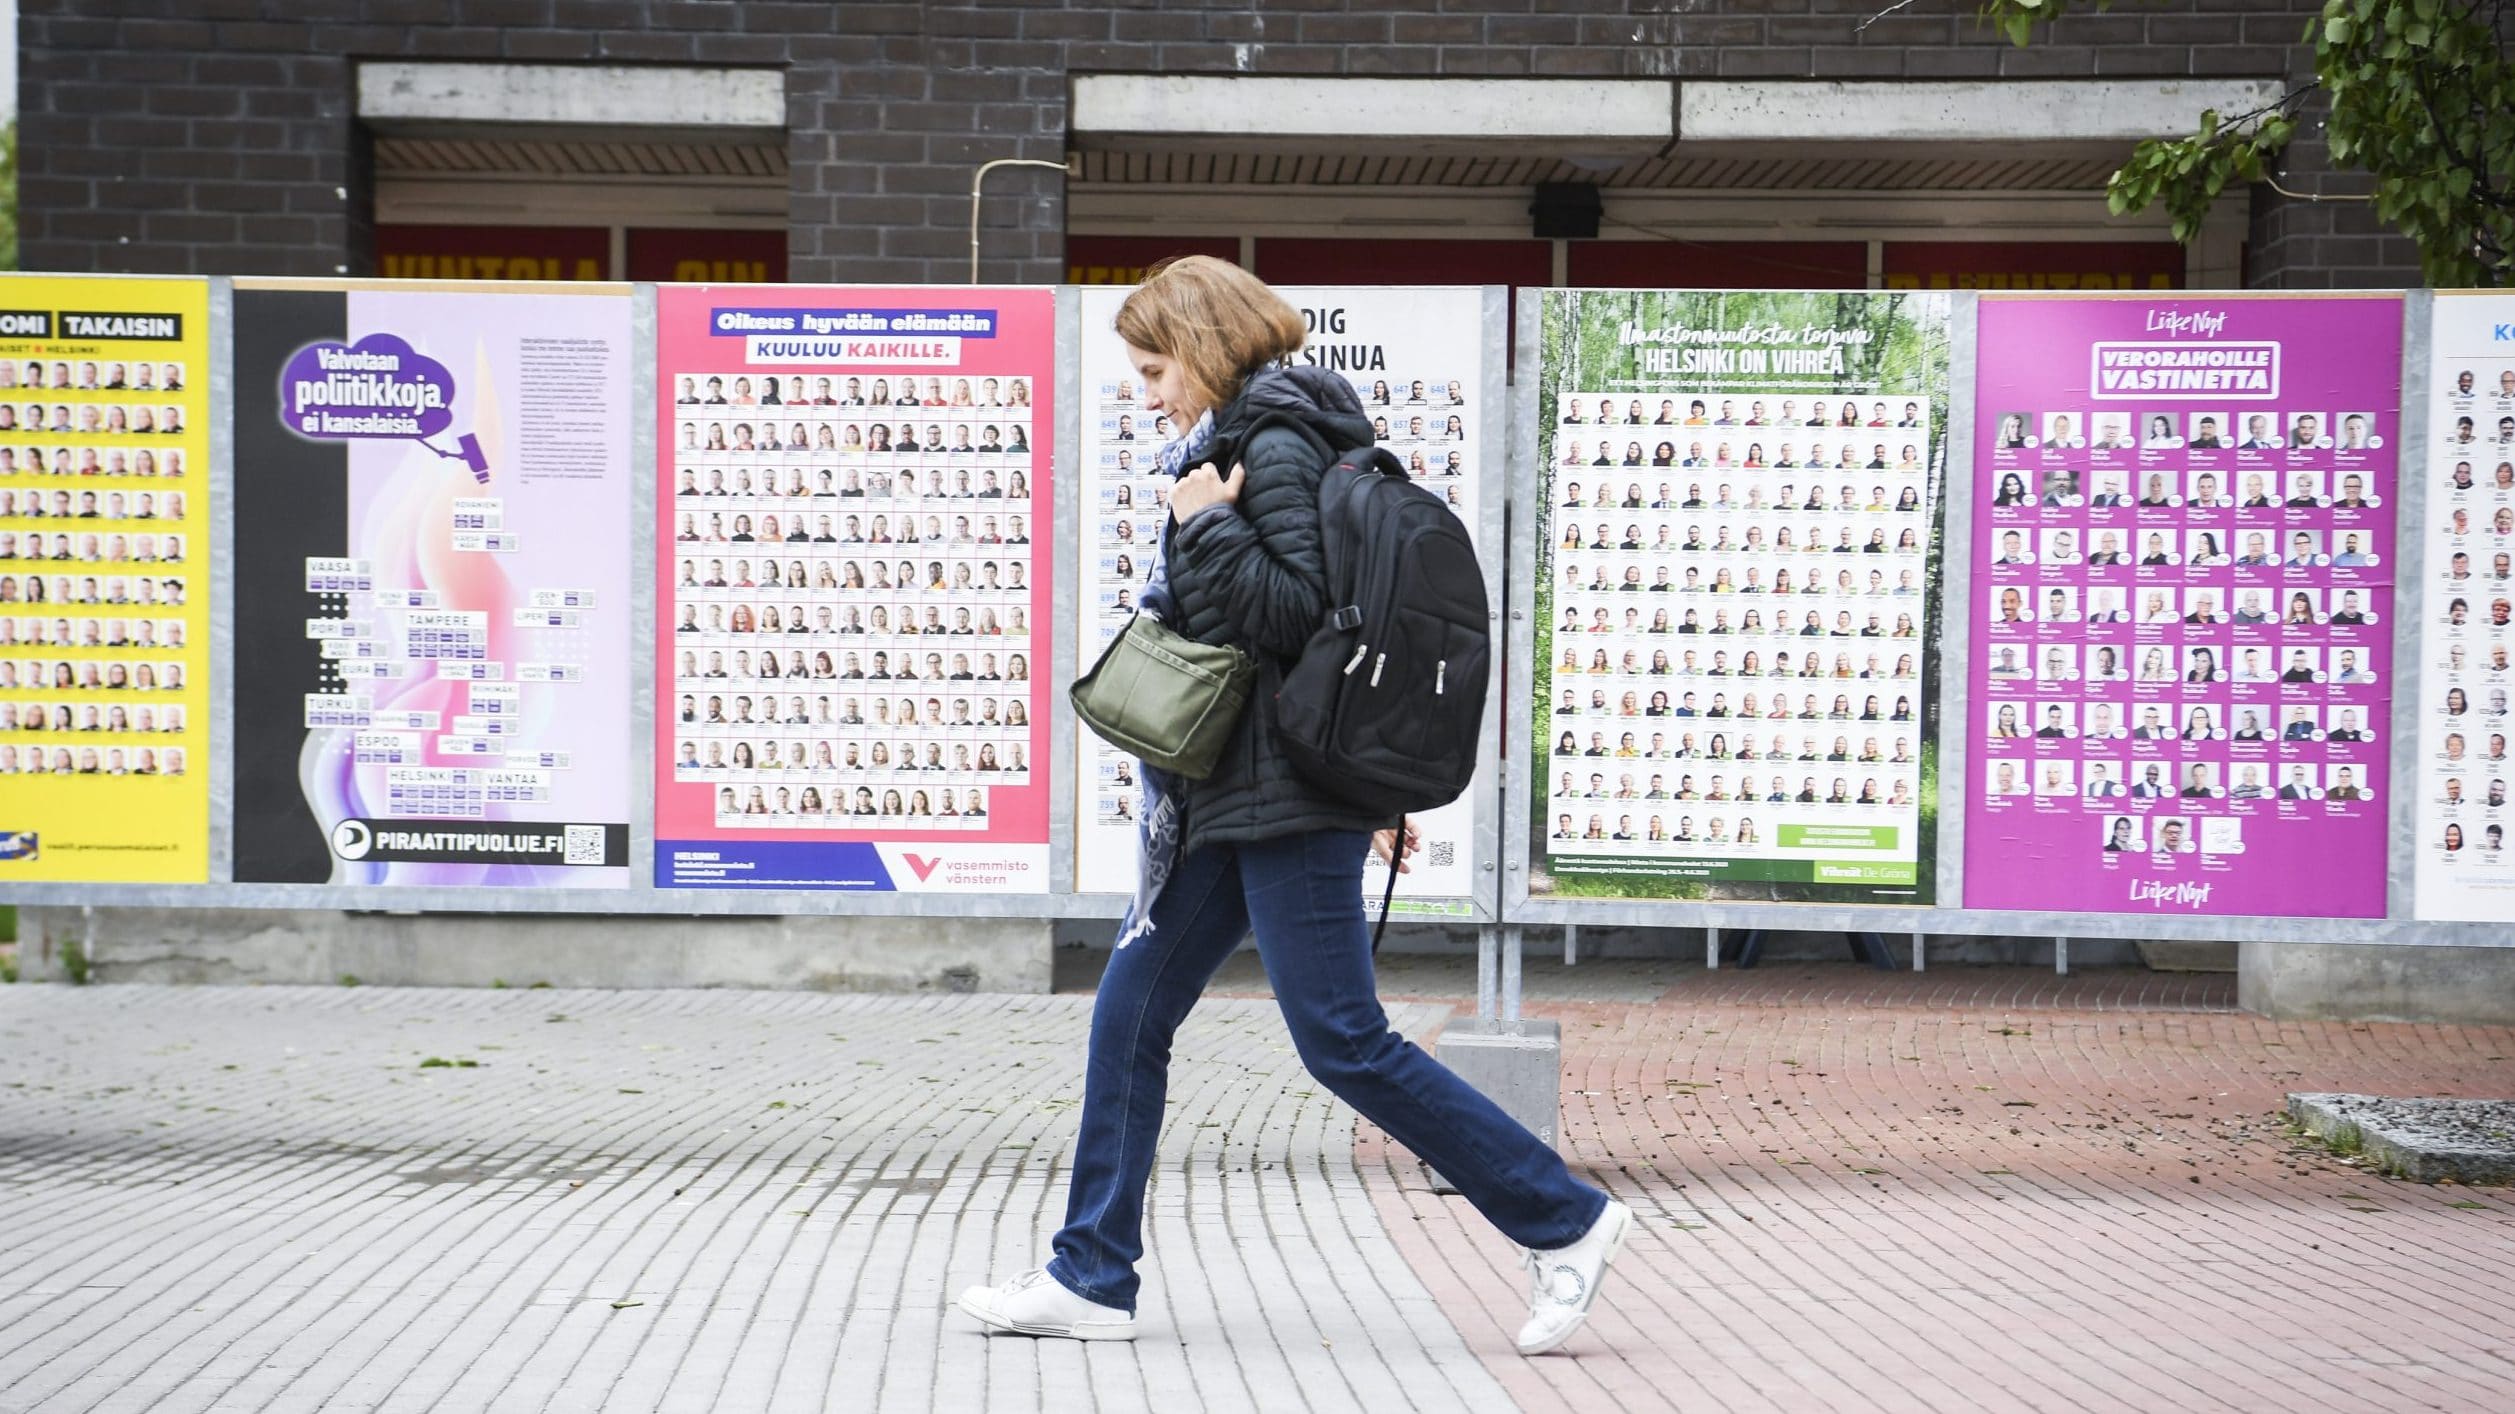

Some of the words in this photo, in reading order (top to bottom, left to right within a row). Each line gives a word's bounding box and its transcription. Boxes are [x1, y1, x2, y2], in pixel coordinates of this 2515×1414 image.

[65, 316, 175, 337] TAKAISIN
[717, 312, 795, 330] Oikeus
[802, 313, 888, 333] hyvään
[891, 314, 991, 331] elämään
[2495, 323, 2515, 341] K
[756, 342, 842, 357] KUULUU
[847, 342, 951, 358] KAIKILLE.
[1303, 345, 1386, 371] SINUA
[317, 348, 399, 371] Valvotaan
[1645, 349, 1735, 373] HELSINKI
[1740, 350, 1767, 374] ON
[1771, 346, 1845, 375] VIHREÄ
[2102, 351, 2271, 367] VERORAHOILLE
[2102, 370, 2269, 390] VASTINETTA
[302, 411, 320, 432] ei
[322, 411, 423, 434] kansalaisia.
[311, 562, 351, 571] VAASA
[408, 614, 470, 626] TAMPERE
[309, 699, 353, 709] TURKU
[357, 736, 400, 747] ESPOO
[390, 771, 449, 781] HELSINKI
[489, 774, 538, 785] VANTAA
[376, 832, 564, 853] PIRAATTIPUOLUE.FI
[946, 858, 1029, 871] vasemmisto
[946, 873, 1007, 885] vänstern
